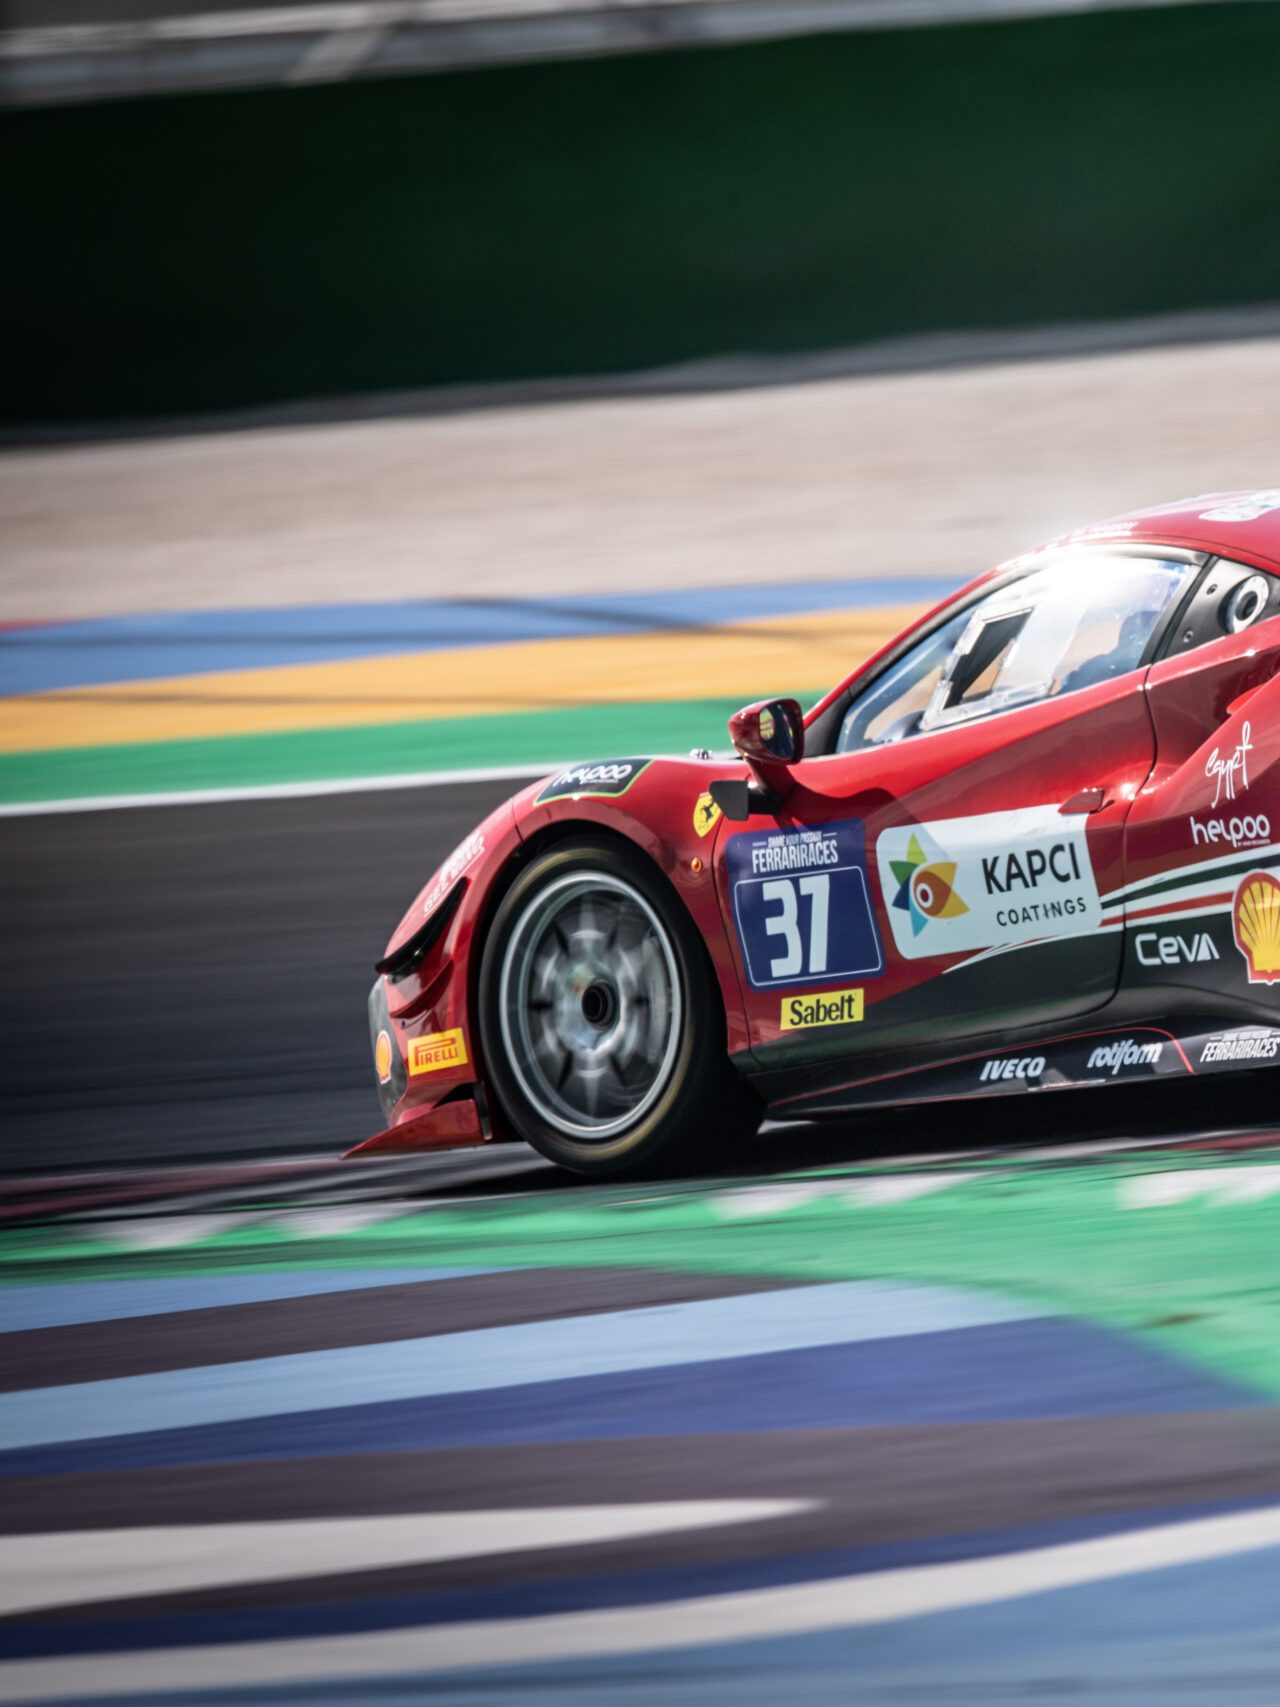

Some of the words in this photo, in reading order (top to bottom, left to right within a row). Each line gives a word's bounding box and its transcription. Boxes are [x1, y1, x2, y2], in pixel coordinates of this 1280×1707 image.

[982, 842, 1081, 895] KAPCI
[762, 874, 830, 978] 37
[996, 897, 1087, 926] COATINGS
[790, 994, 855, 1025] Sabelt
[414, 1038, 458, 1067] PIRELLI
[979, 1056, 1046, 1082] IVECO
